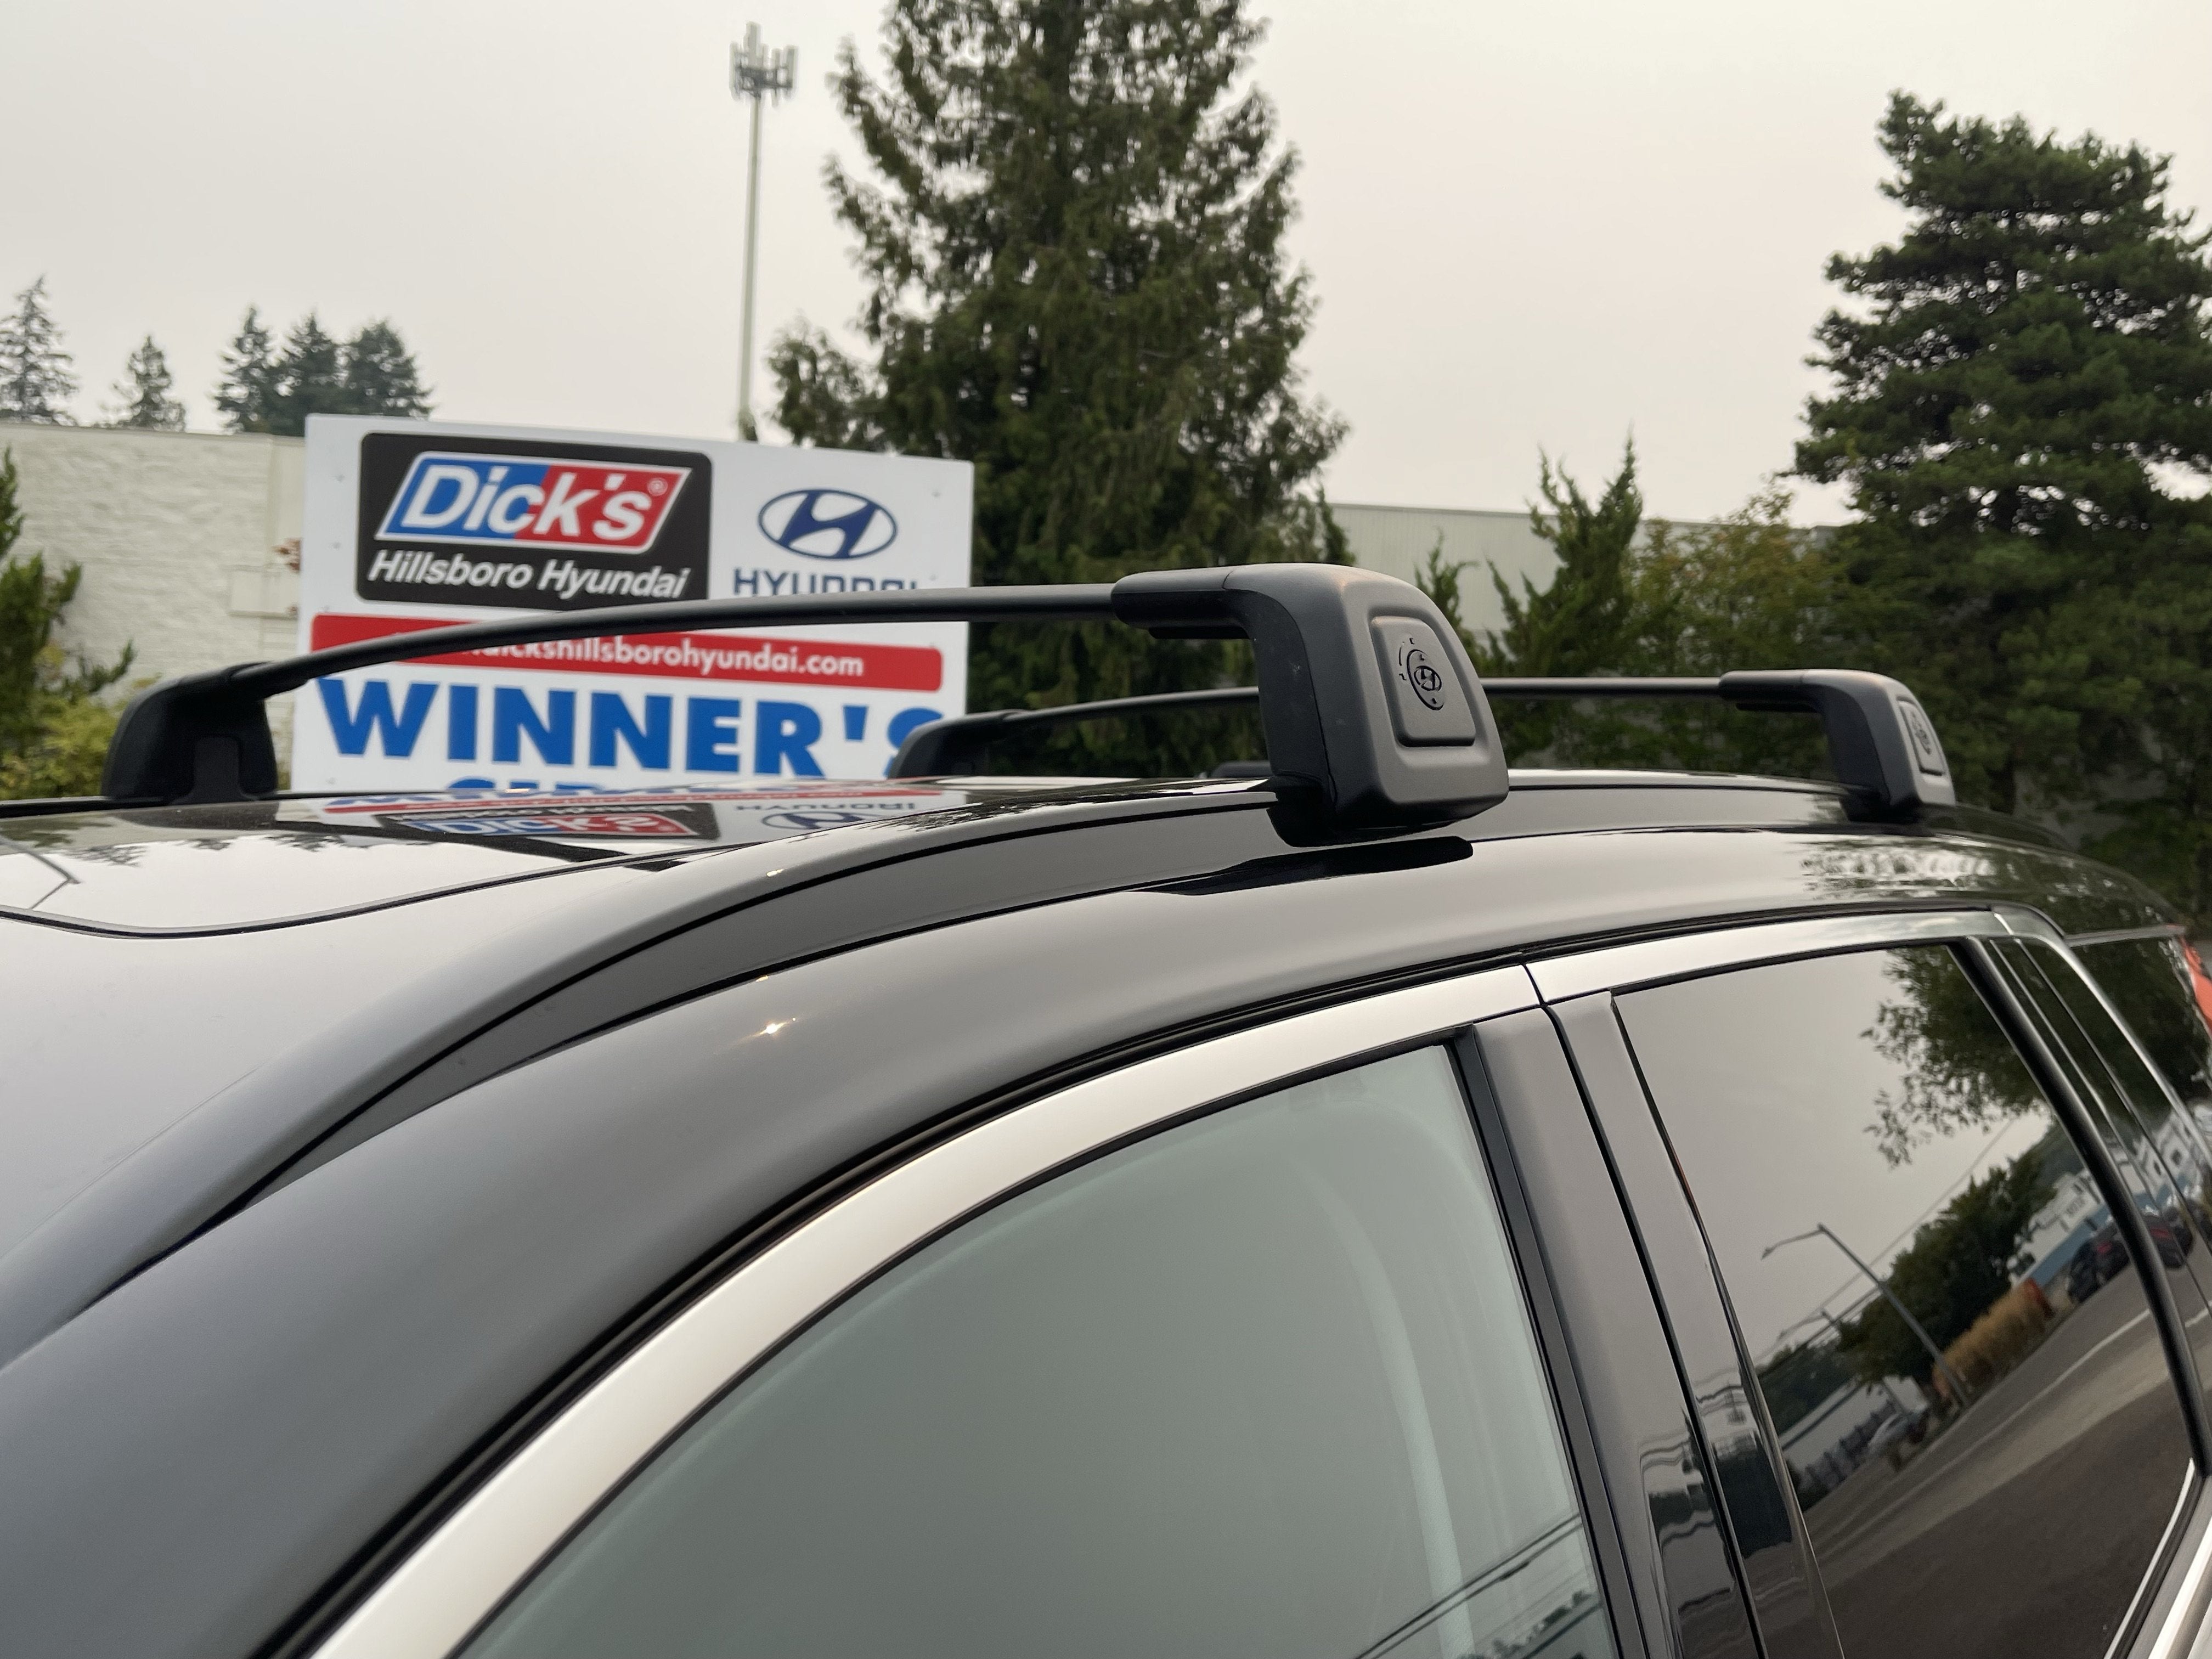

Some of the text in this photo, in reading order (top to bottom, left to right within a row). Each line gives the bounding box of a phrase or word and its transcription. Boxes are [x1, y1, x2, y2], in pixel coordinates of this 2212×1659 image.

[400, 464, 652, 541] Dick's
[368, 550, 691, 600] Hillsboro Hyundai
